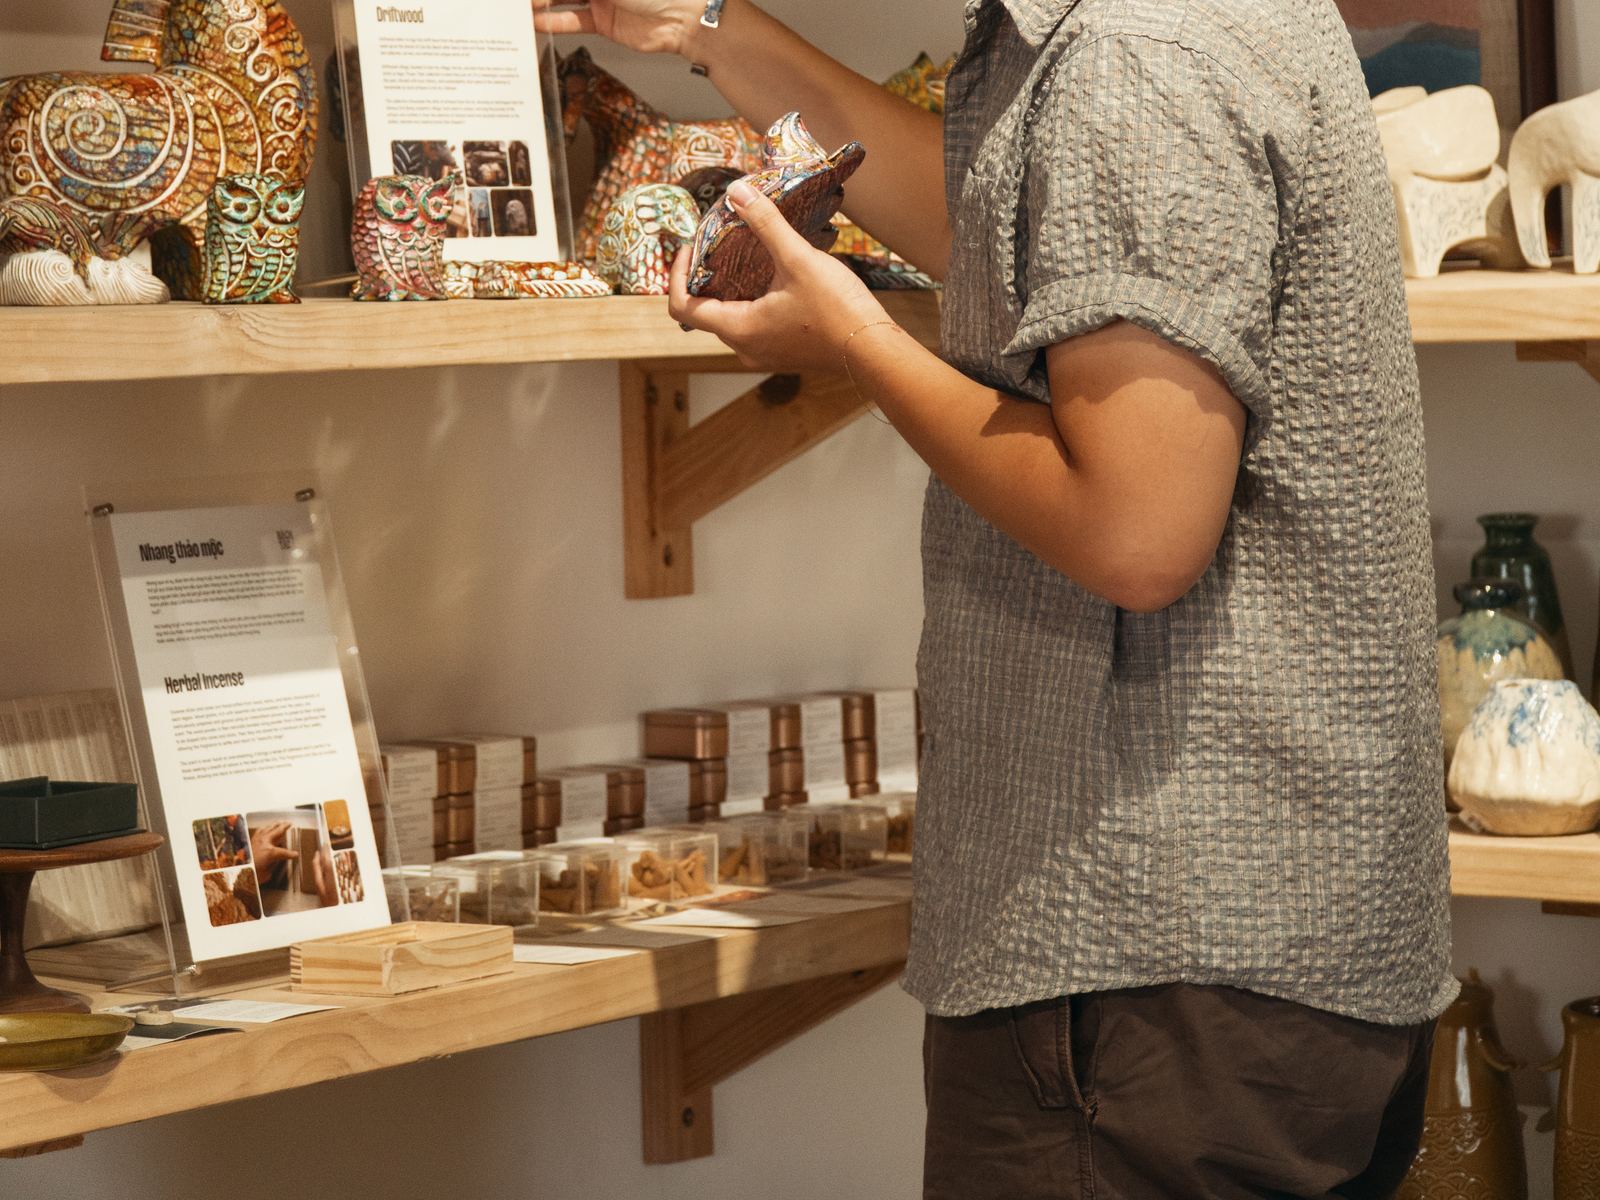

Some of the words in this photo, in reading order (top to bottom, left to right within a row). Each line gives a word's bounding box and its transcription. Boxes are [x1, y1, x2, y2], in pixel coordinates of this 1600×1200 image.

[376, 6, 424, 23] Driftwood
[139, 543, 176, 564] Nhang
[175, 539, 200, 560] thảo
[200, 538, 225, 560] mộc
[164, 672, 202, 694] Herbal
[202, 671, 245, 691] Incense
